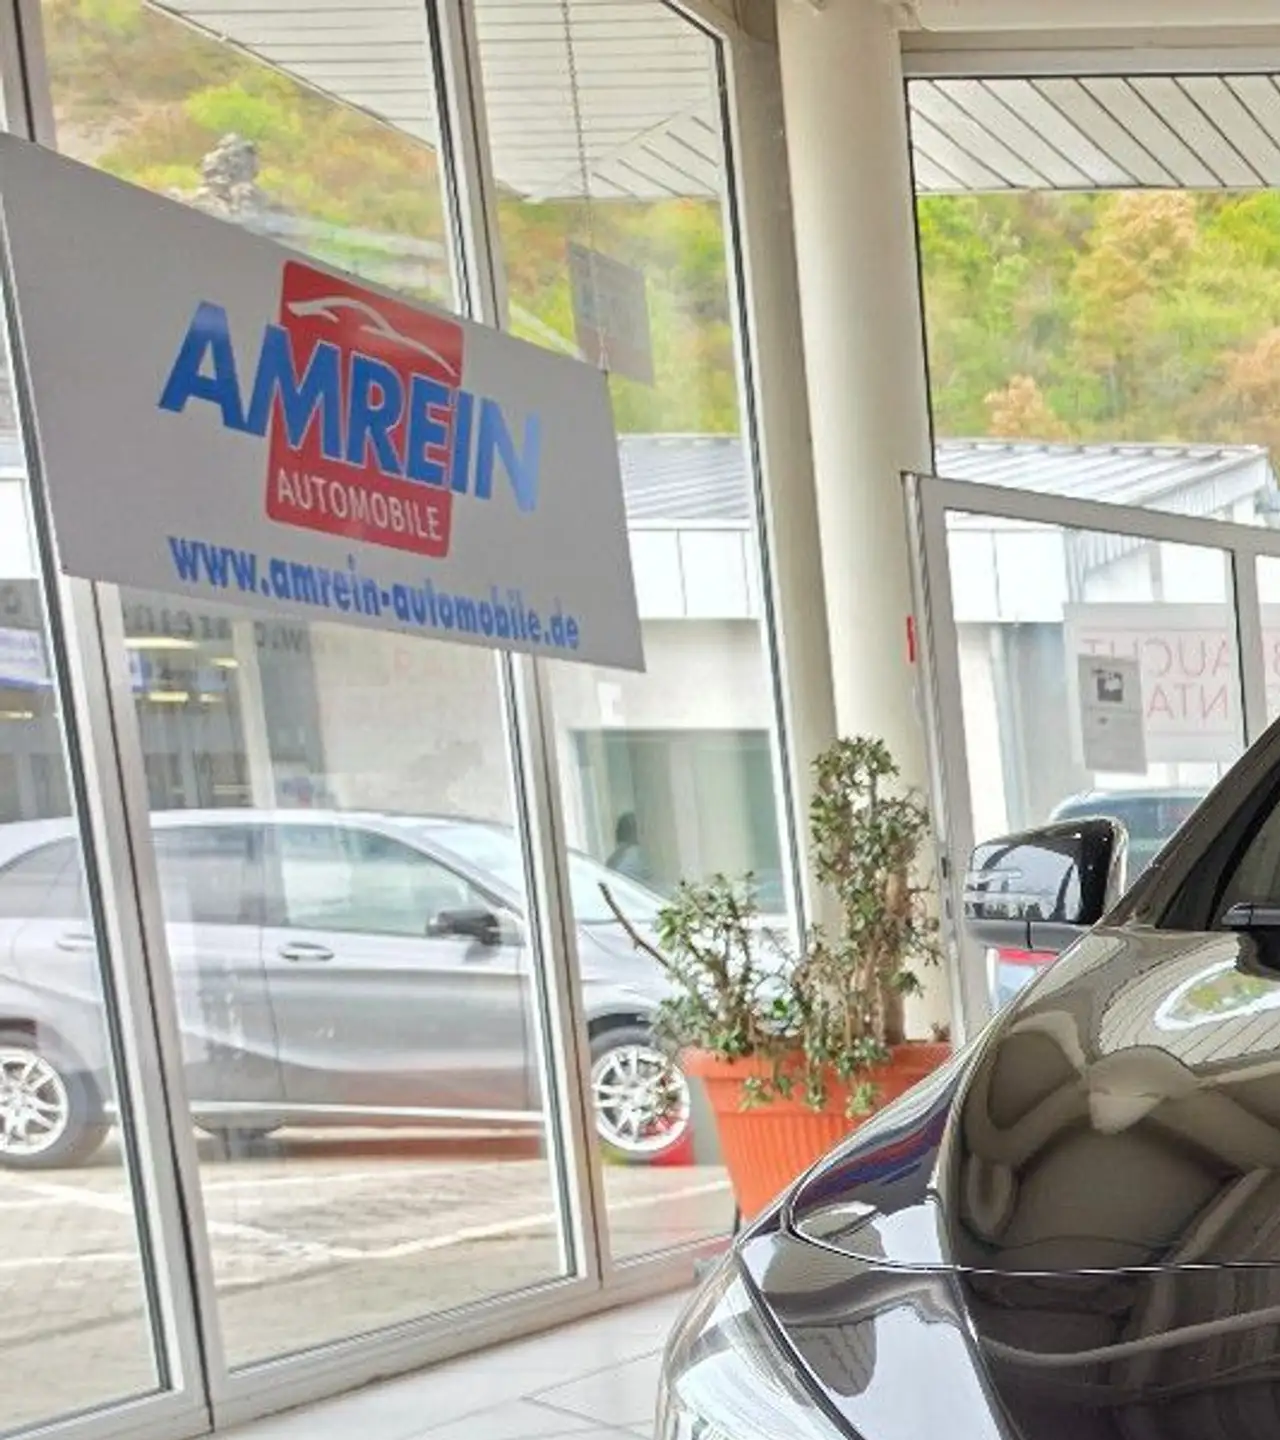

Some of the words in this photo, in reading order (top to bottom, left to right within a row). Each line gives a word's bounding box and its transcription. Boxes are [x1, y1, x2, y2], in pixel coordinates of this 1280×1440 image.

[159, 300, 542, 513] AMREIN
[277, 467, 443, 542] AUTOMOBILE
[167, 535, 581, 650] www.amrein-automobile.de
